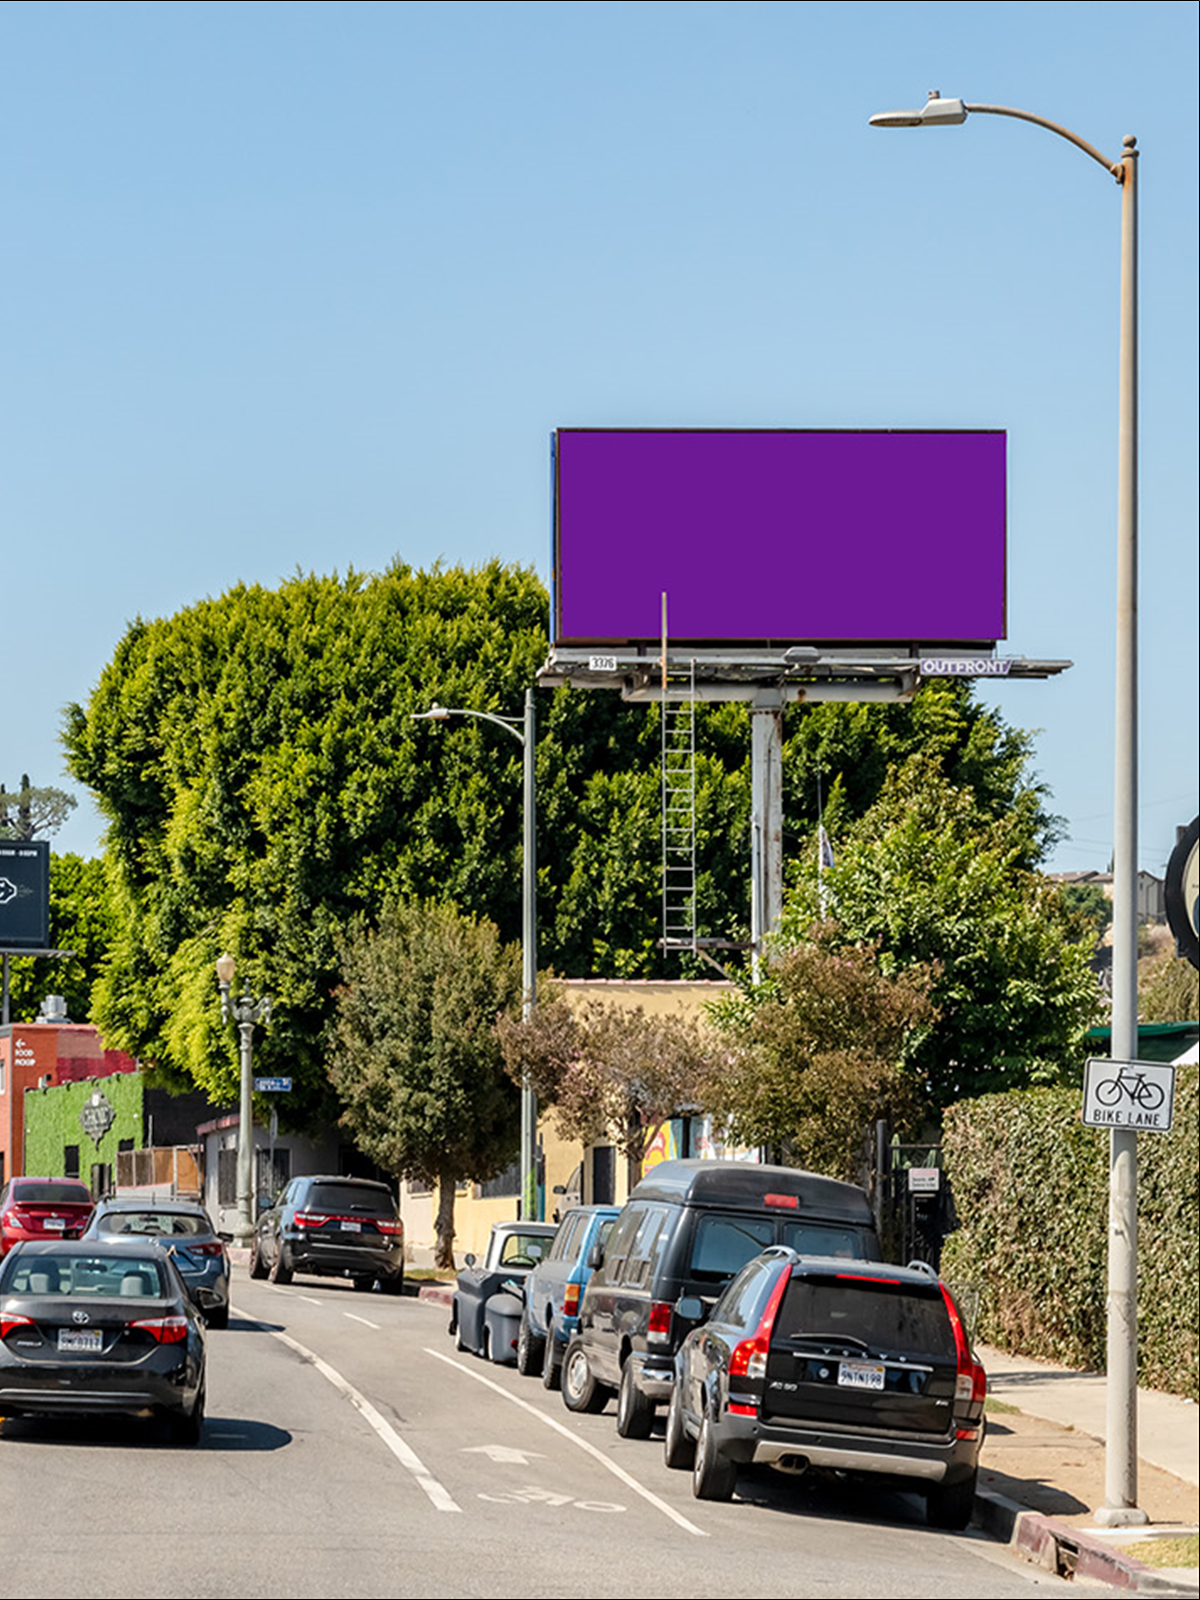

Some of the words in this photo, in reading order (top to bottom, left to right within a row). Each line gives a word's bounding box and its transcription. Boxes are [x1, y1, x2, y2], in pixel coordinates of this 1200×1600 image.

[923, 659, 1007, 674] OUTFRONT
[1093, 1109, 1123, 1124] BIKE
[1128, 1112, 1161, 1126] LANE
